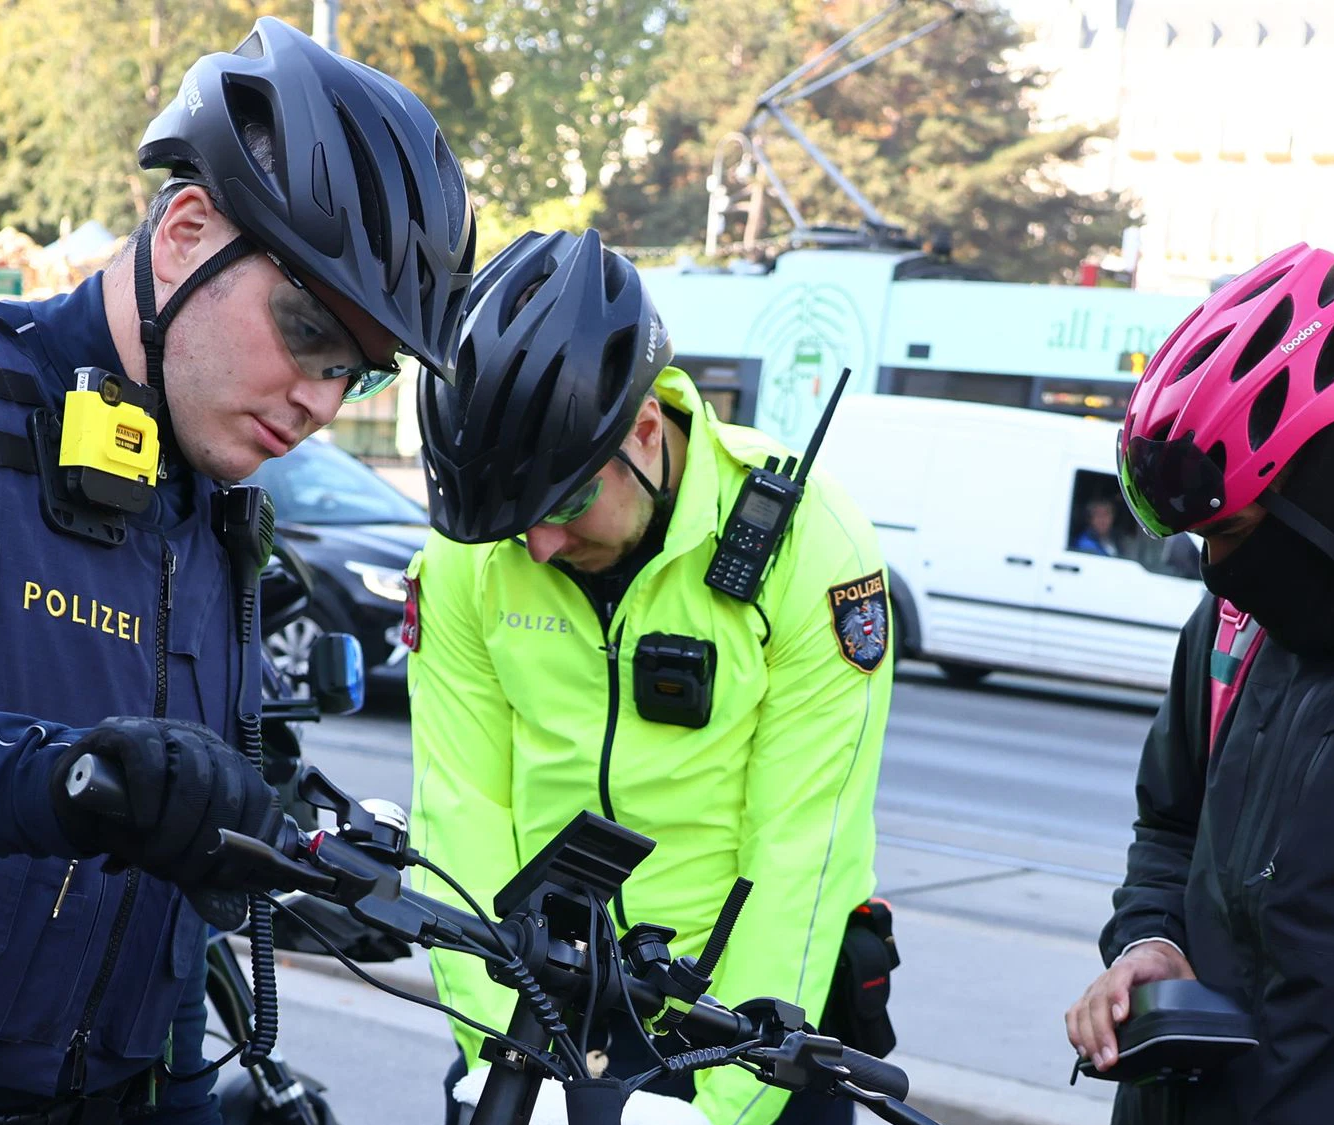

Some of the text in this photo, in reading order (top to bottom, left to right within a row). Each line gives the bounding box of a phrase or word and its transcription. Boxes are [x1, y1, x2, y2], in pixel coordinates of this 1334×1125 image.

[1047, 309, 1091, 350] all
[1280, 320, 1323, 354] foodora
[23, 580, 140, 645] POLIZEI
